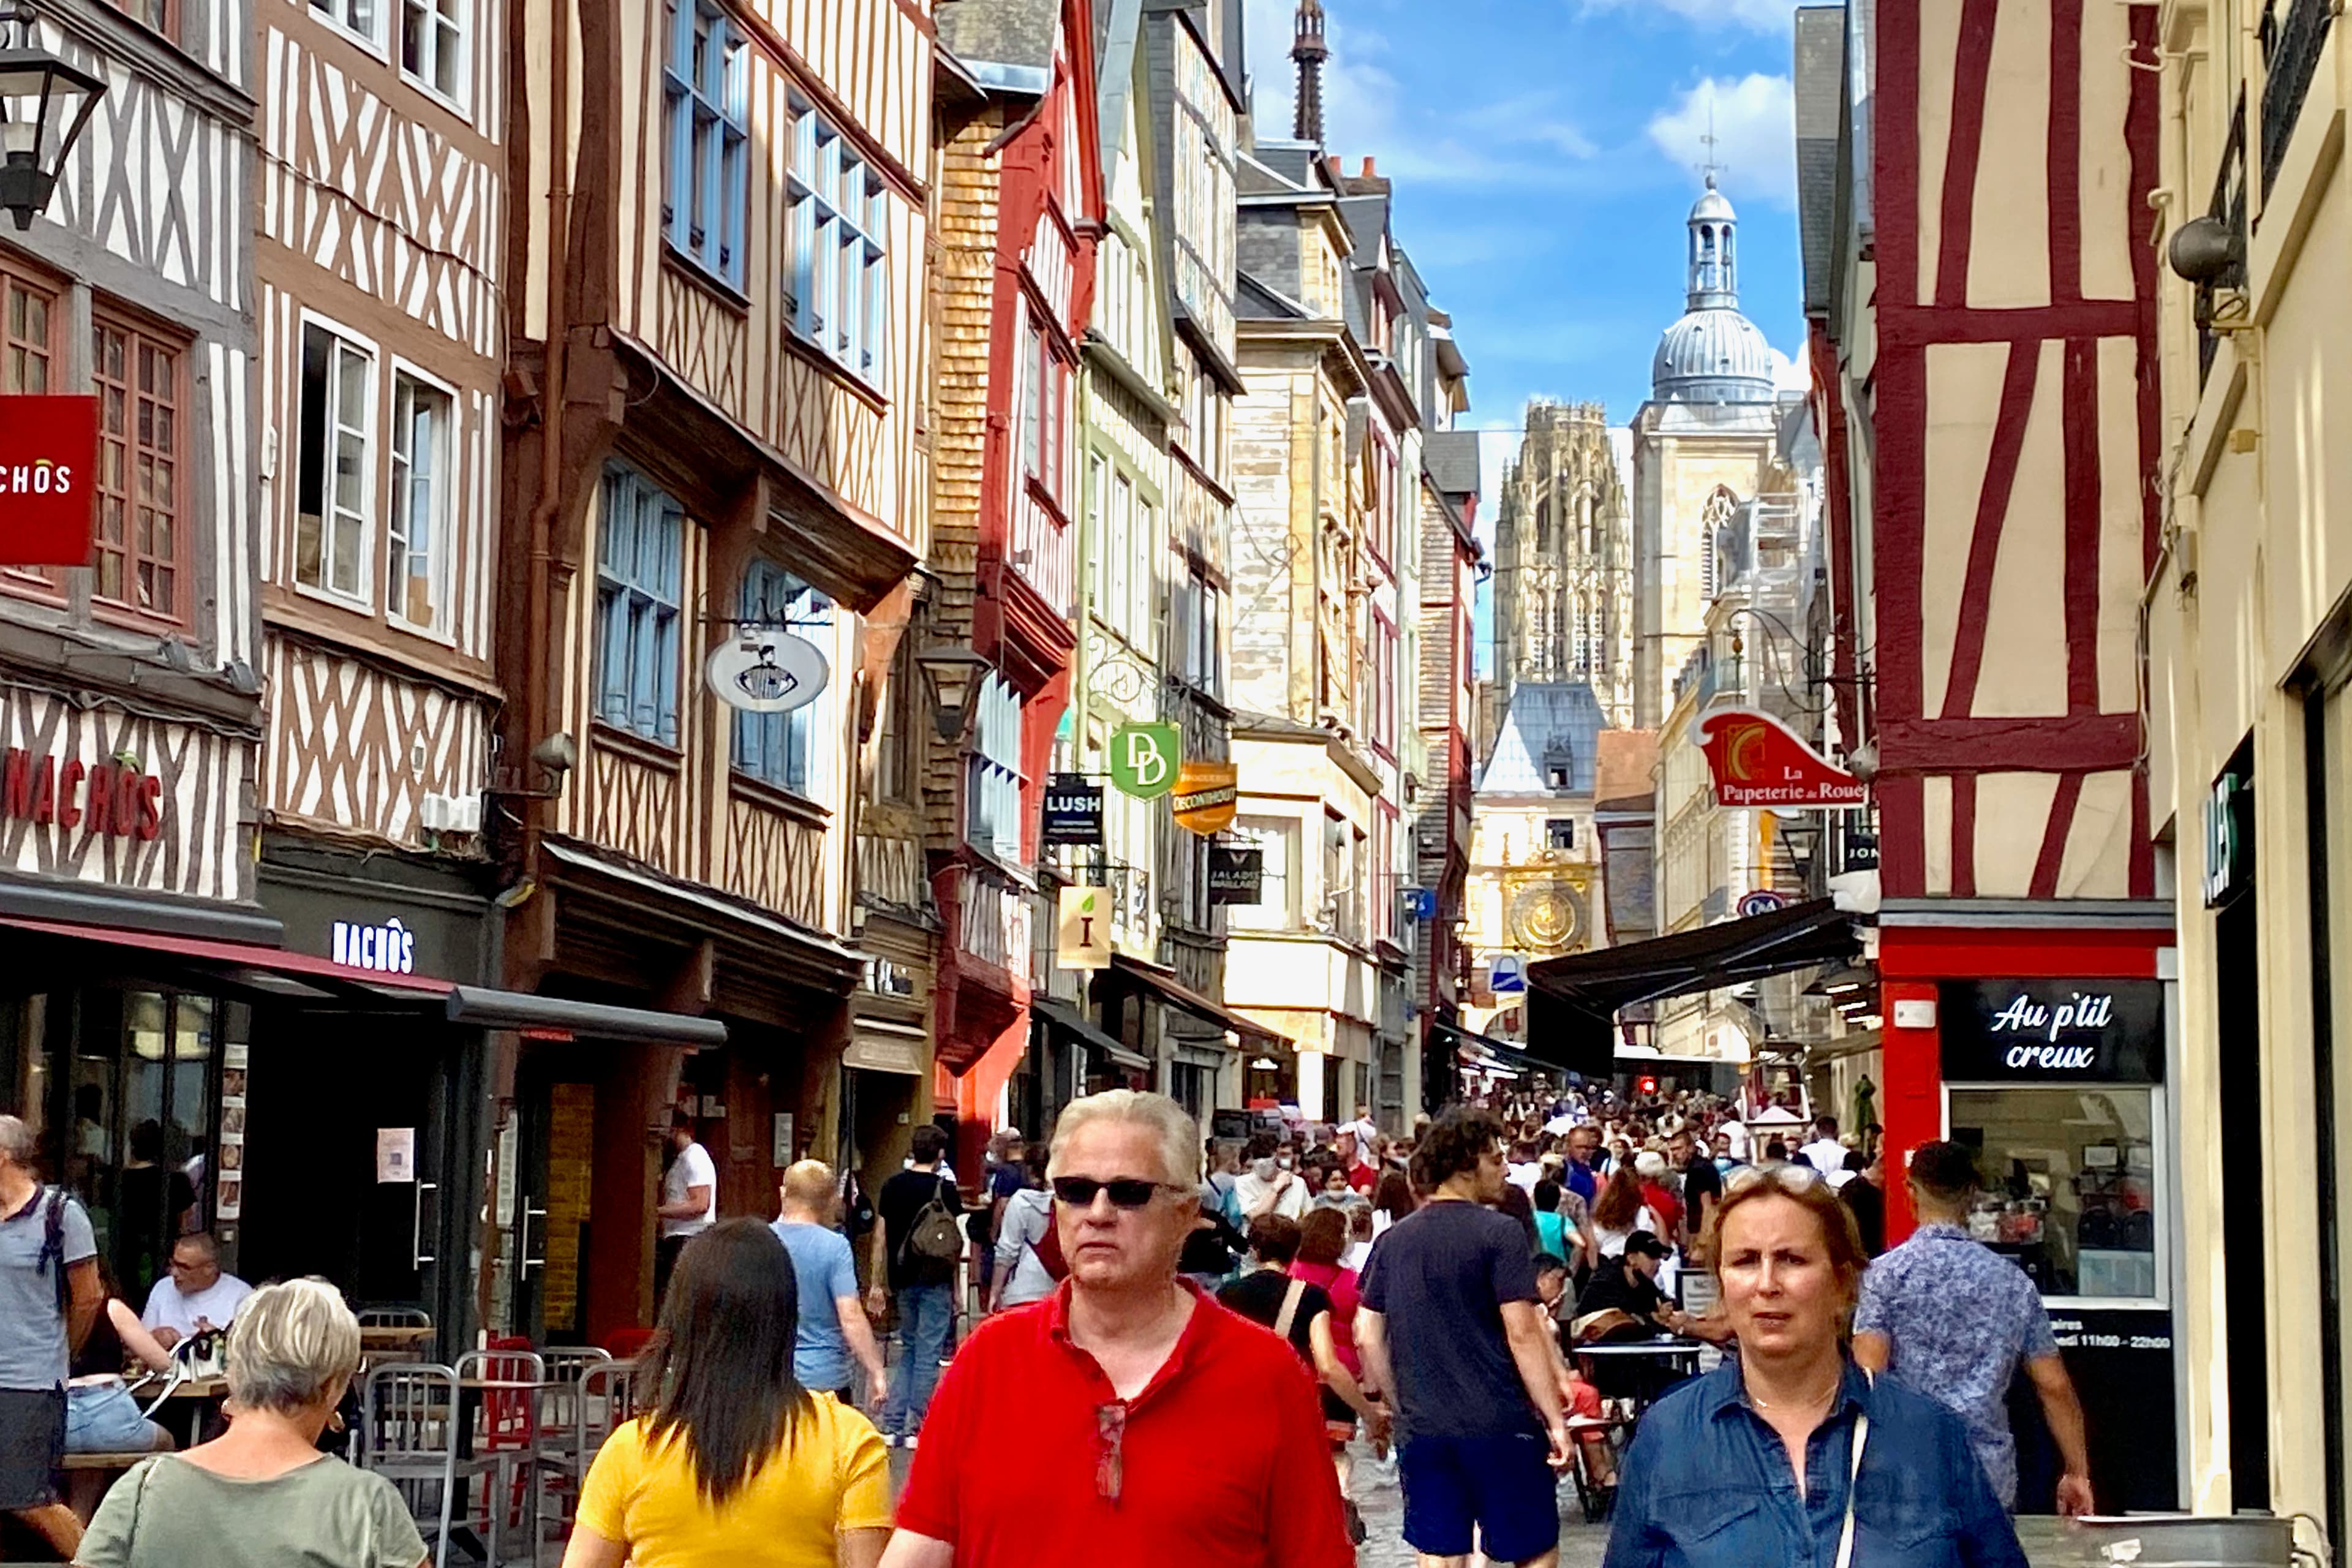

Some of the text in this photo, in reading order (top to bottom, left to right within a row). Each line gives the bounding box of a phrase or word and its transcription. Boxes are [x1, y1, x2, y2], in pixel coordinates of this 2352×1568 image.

[1784, 766, 1803, 780] La
[1047, 796, 1101, 813] LUSH
[1723, 783, 1804, 805] Papeterie
[1991, 994, 2049, 1031] Au
[2006, 1046, 2095, 1068] creux
